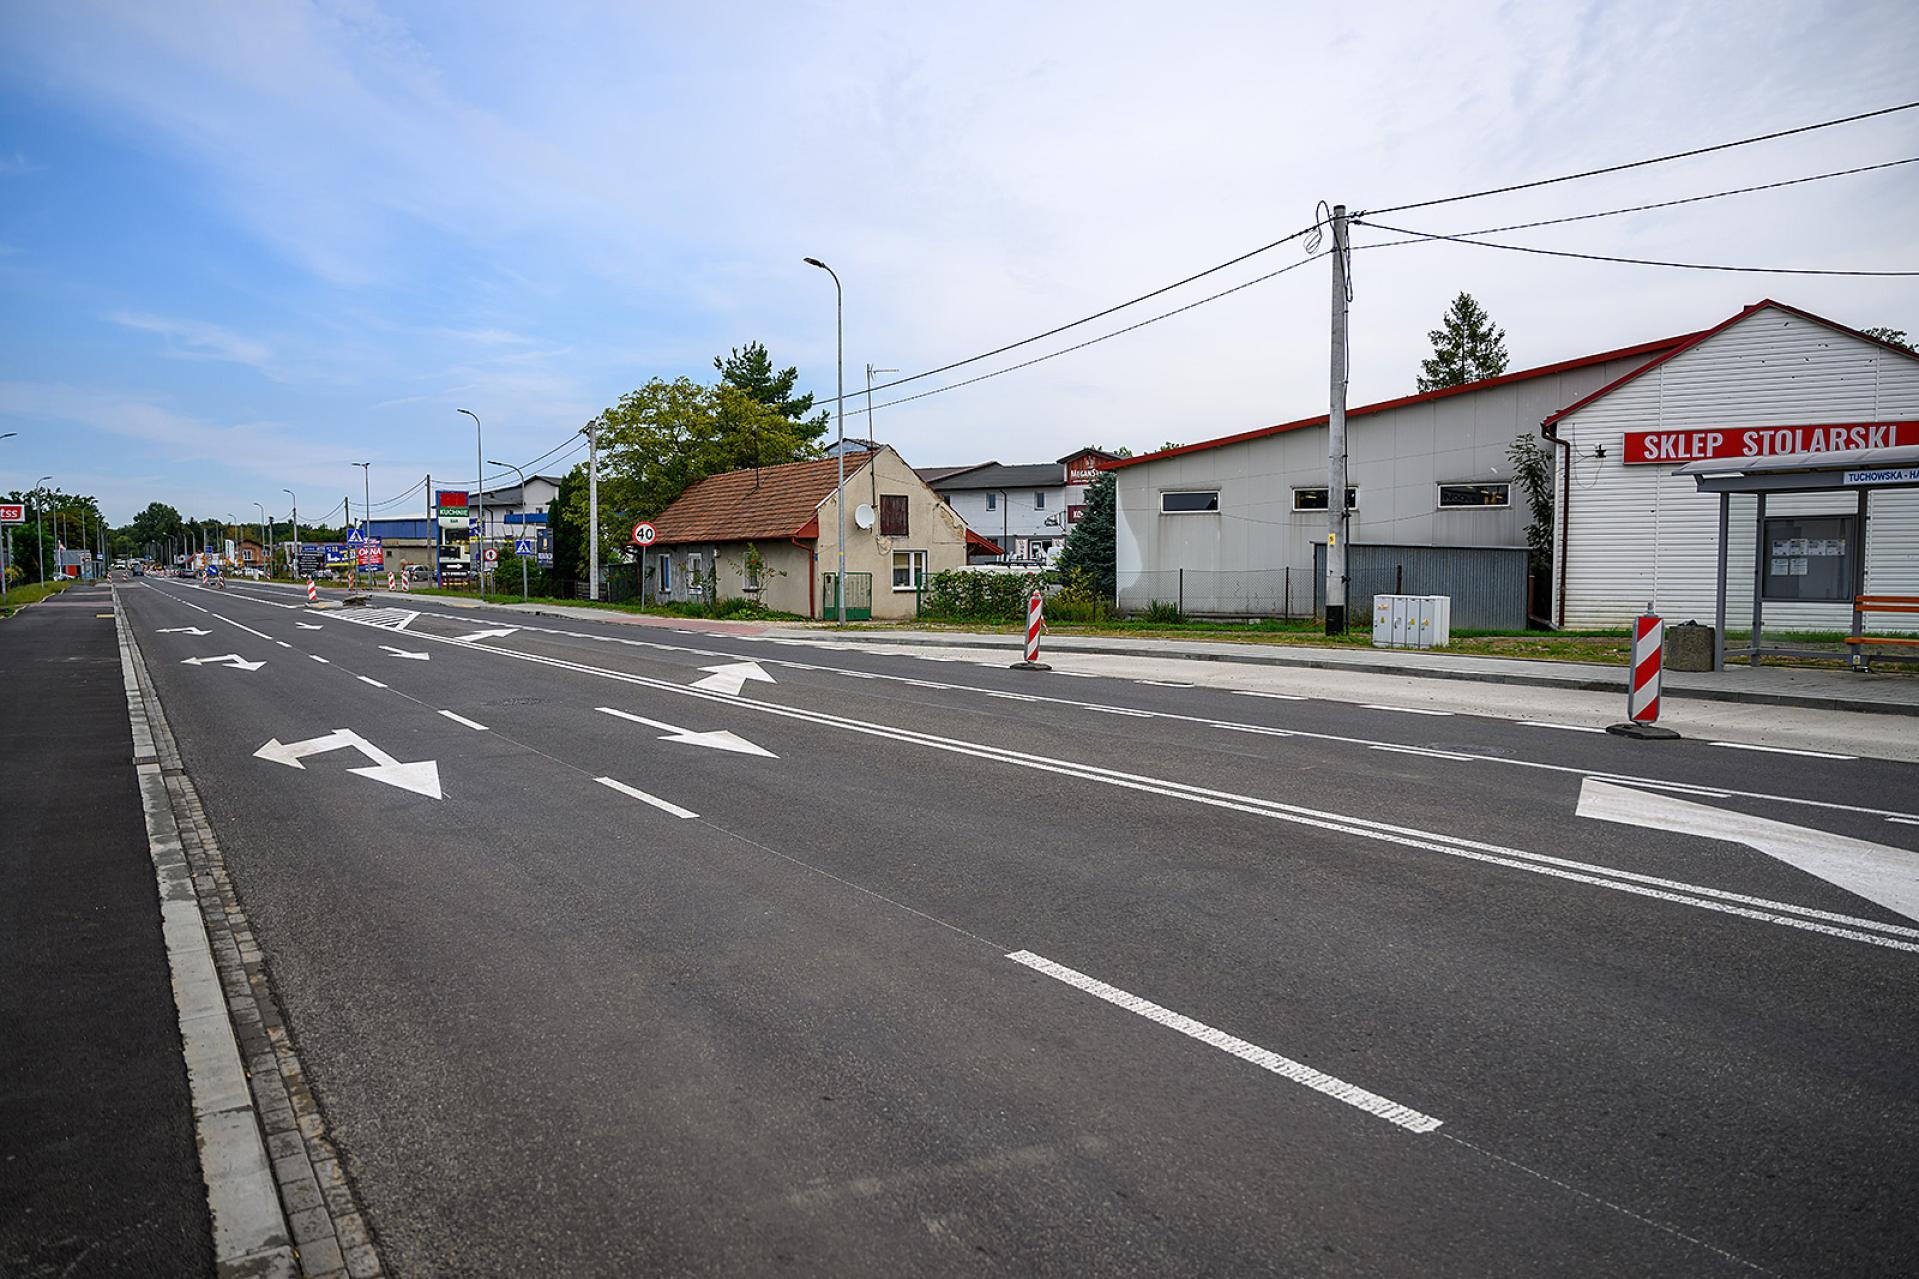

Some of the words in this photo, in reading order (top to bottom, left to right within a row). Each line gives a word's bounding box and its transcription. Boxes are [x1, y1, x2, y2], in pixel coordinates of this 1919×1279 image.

[1644, 433, 1723, 459] SKLEP
[1743, 425, 1897, 457] STOLARSKI
[1848, 471, 1903, 482] TUCHOWSKA
[637, 528, 654, 540] 40
